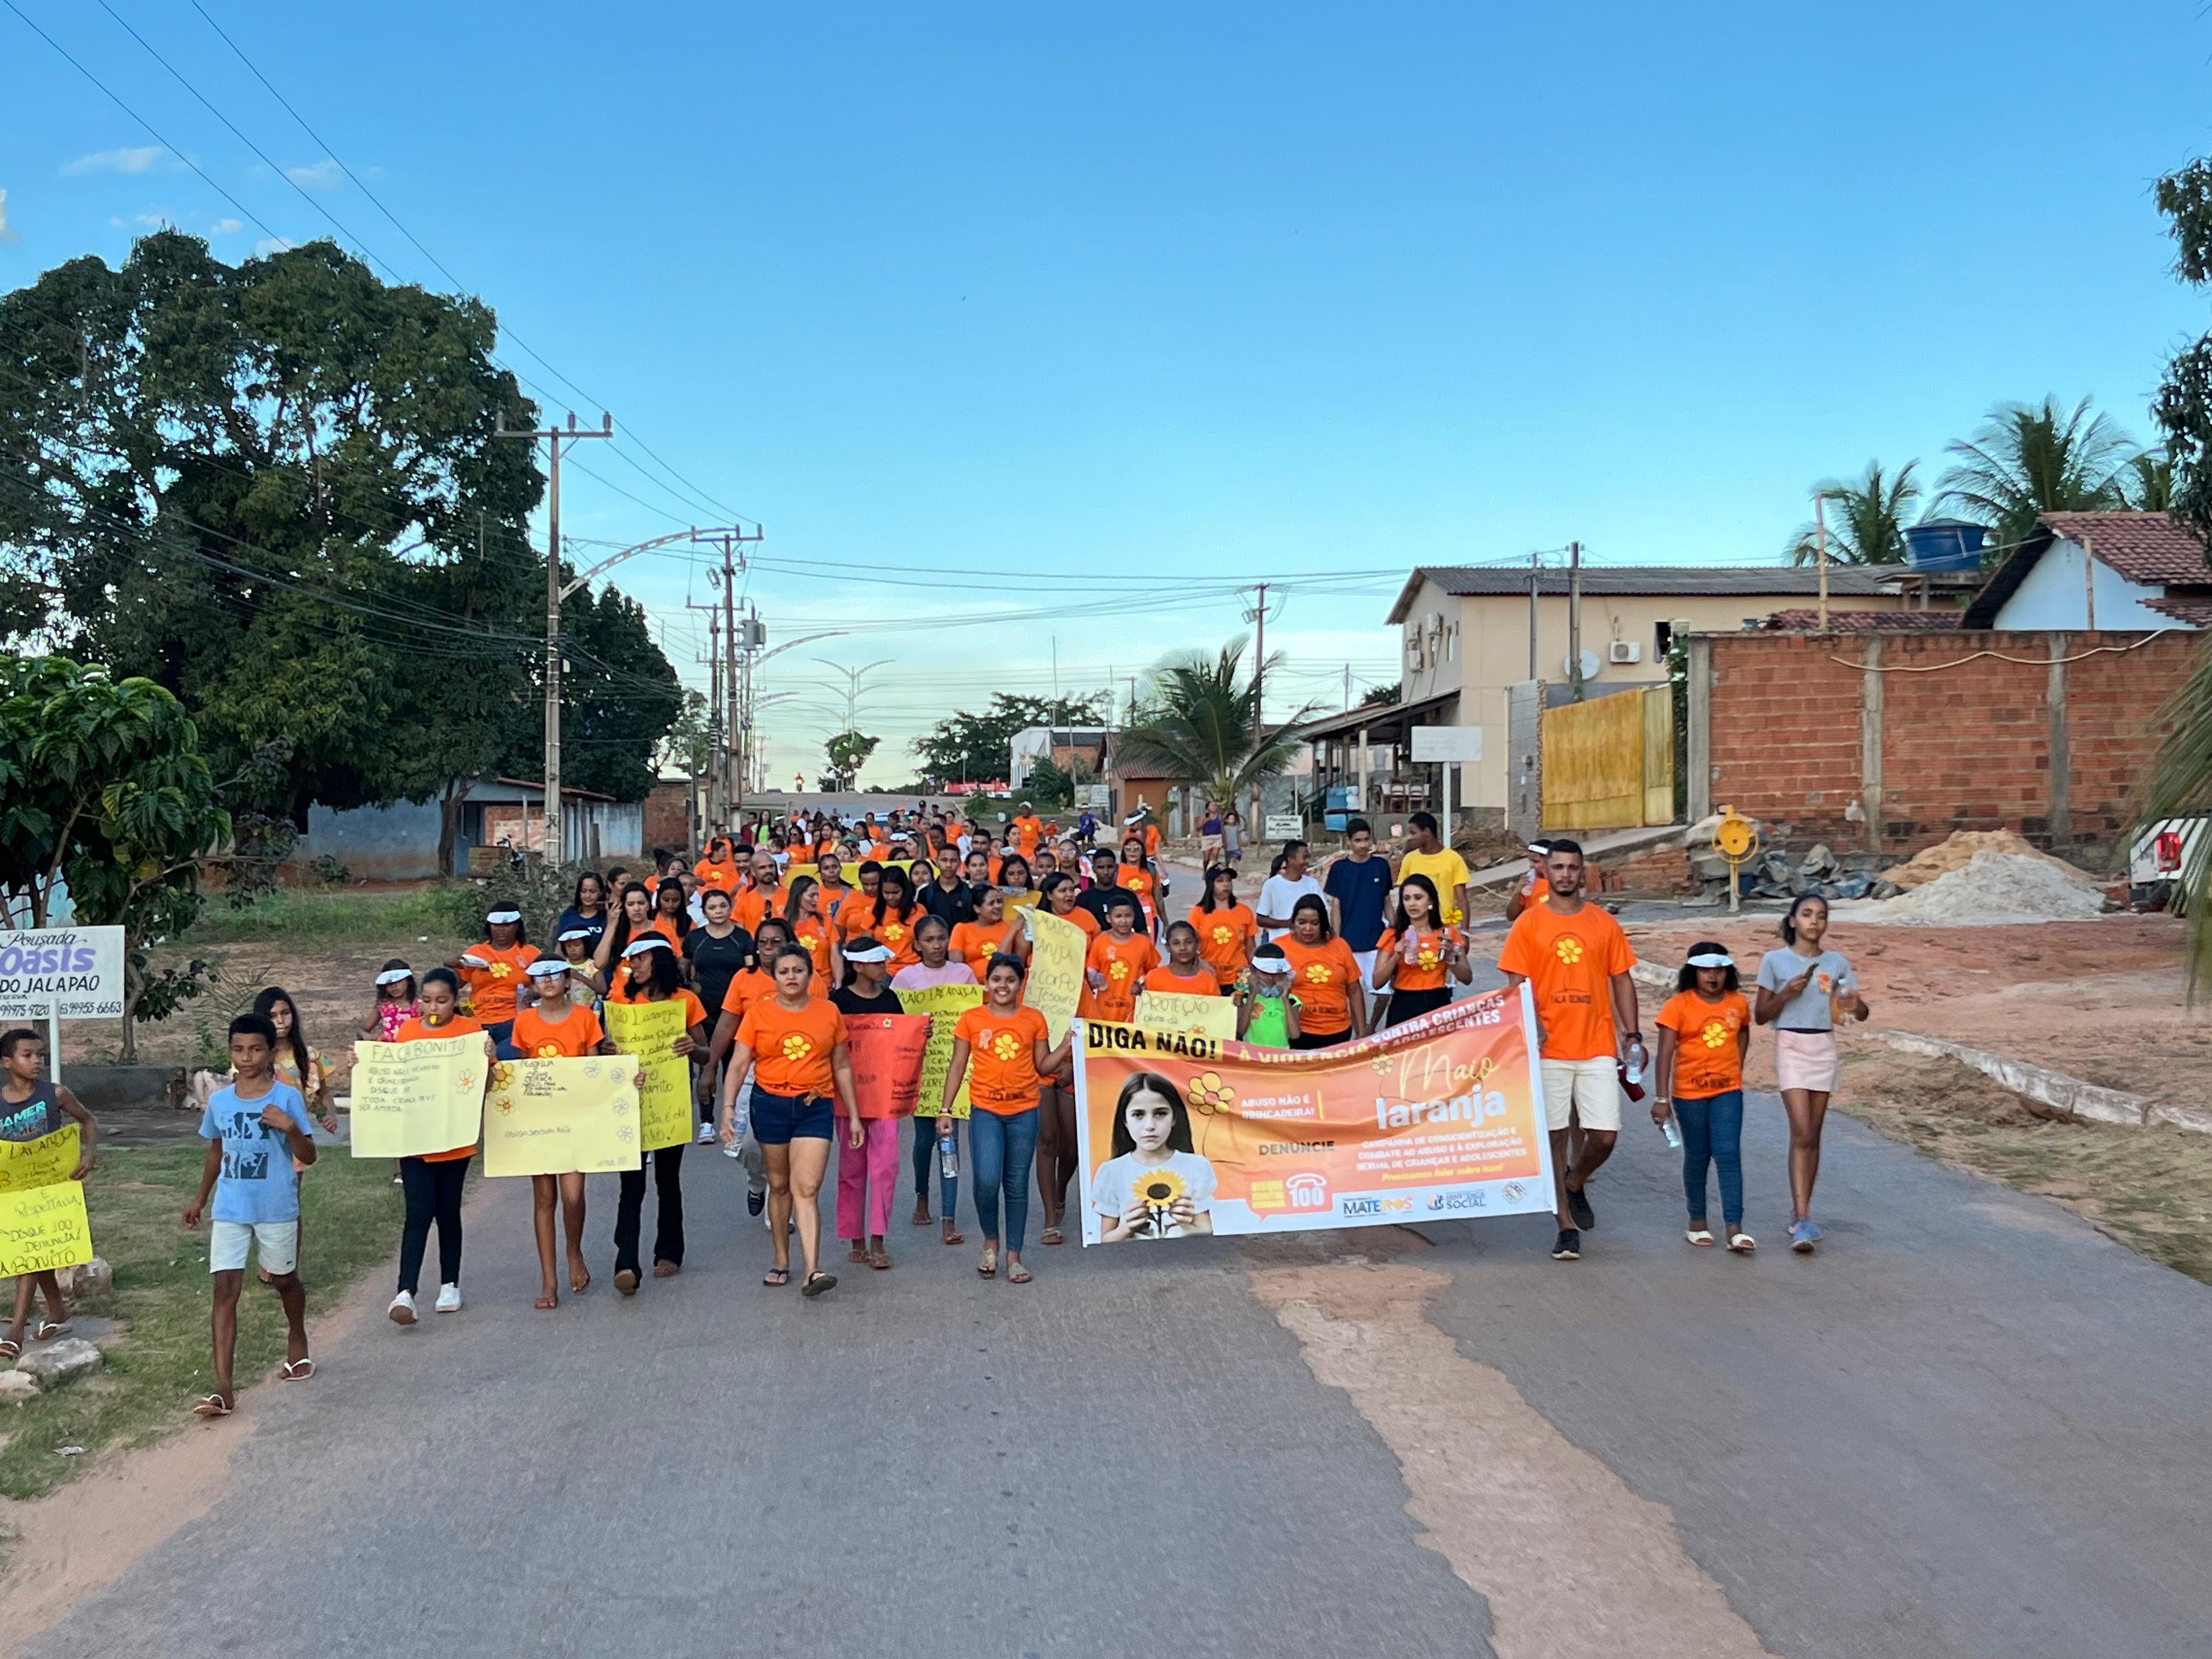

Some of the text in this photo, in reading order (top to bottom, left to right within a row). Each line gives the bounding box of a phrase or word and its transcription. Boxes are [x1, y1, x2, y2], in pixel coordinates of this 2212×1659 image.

[1372, 995, 1505, 1042] CONTRA CRIANÇAS
[414, 1039, 465, 1057] BONITO
[1089, 1023, 1216, 1059] DIGA NÃO!
[1399, 1044, 1500, 1099] Maio
[1241, 1094, 1310, 1108] ABUSO NÃO É
[1375, 1084, 1506, 1130] laranja
[1259, 1140, 1335, 1155] DENUNCIE
[1415, 1136, 1425, 1144] DE
[1358, 1149, 1401, 1159] COMBATE
[1418, 1146, 1447, 1154] ABUSO
[1356, 1161, 1390, 1171] SEXUAL
[1391, 1160, 1403, 1168] DE
[1290, 1187, 1324, 1206] 100
[1447, 1199, 1486, 1209] SOCIAL
